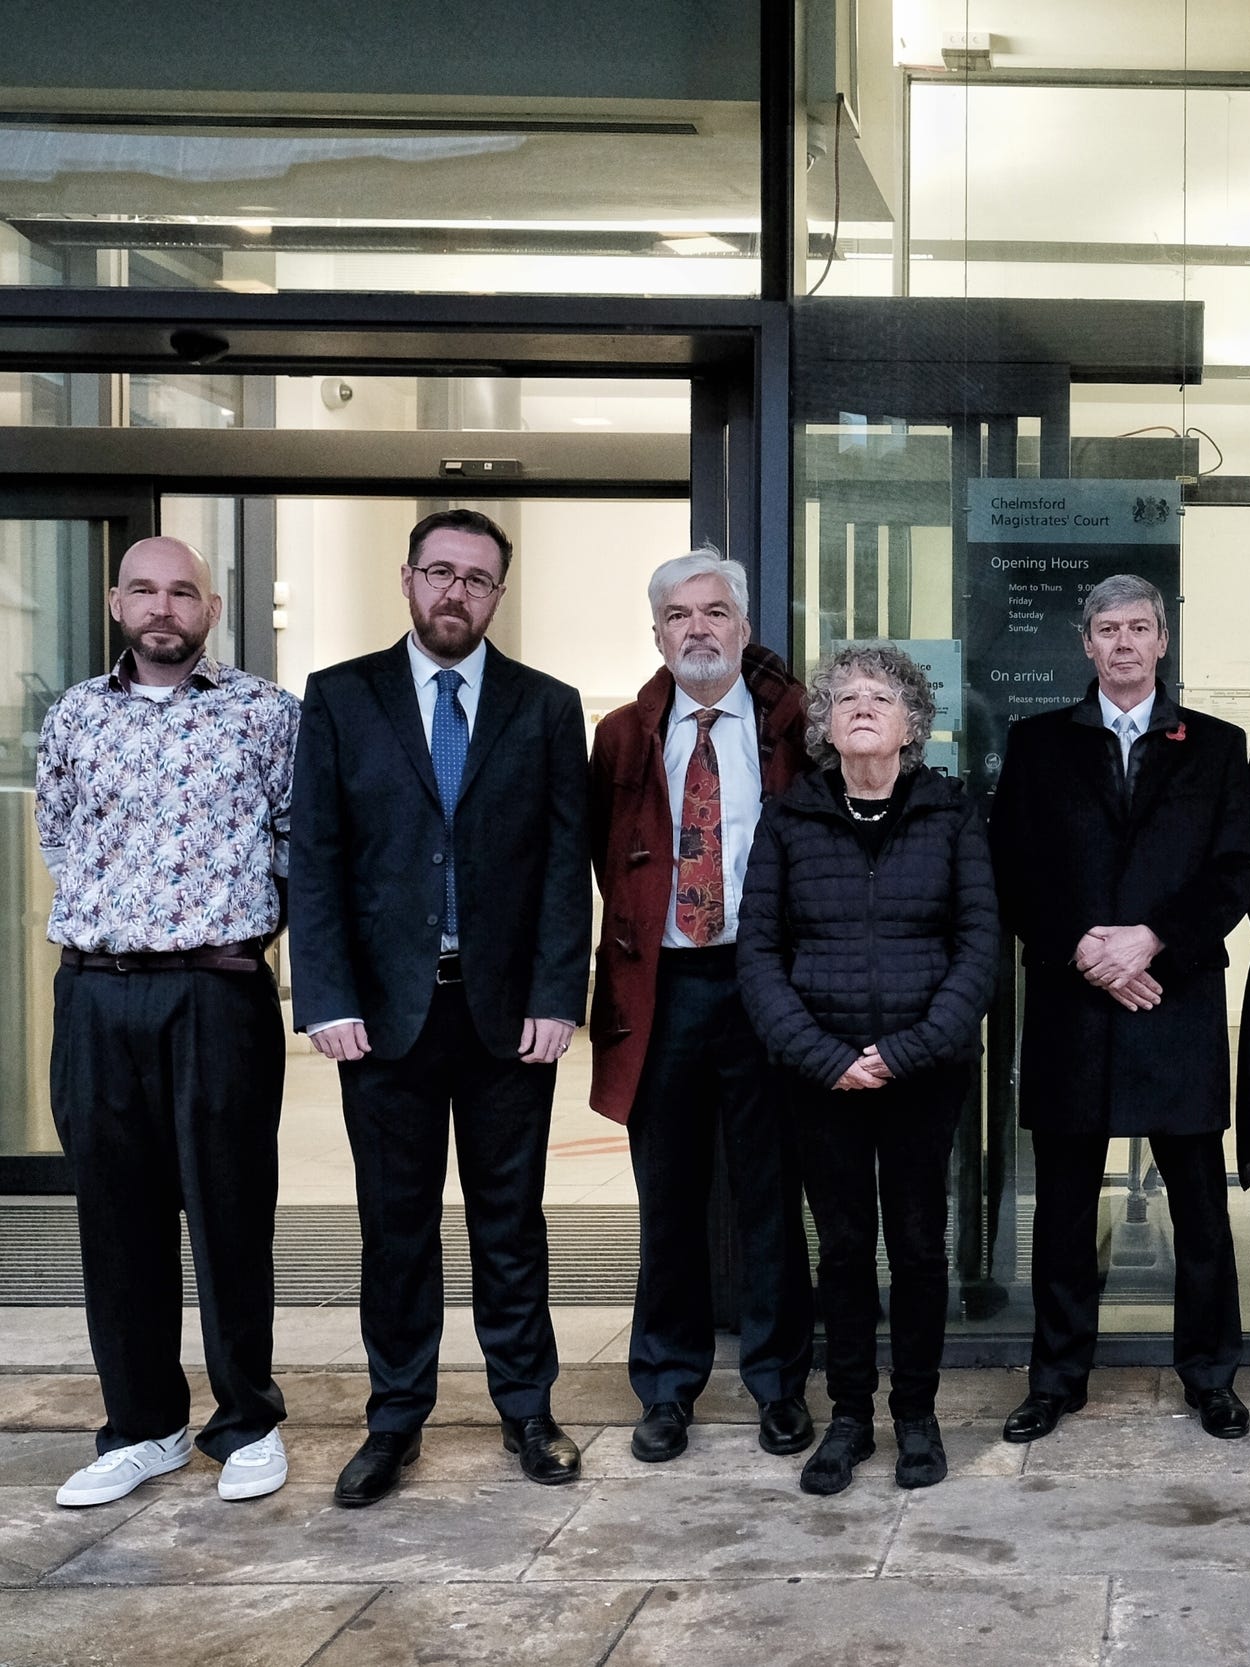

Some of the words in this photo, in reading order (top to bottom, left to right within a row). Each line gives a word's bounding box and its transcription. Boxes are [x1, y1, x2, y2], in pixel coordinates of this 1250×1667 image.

[991, 497, 1066, 510] Chelmsford
[991, 514, 1070, 528] Magistrates'
[1073, 514, 1110, 527] Court
[991, 556, 1047, 571] Opening
[1051, 557, 1090, 569] Hours
[1008, 584, 1028, 592] Mon
[1030, 584, 1039, 592] to
[1040, 584, 1063, 592] Thurs
[1008, 597, 1033, 606] Friday
[1008, 611, 1045, 620] Saturday
[1008, 624, 1039, 634] Sunday
[990, 670, 1010, 682] On
[1013, 669, 1054, 682] arrival
[926, 681, 945, 690] ags
[1008, 695, 1033, 703] Please
[1035, 696, 1060, 705] report
[1008, 714, 1019, 722] All
